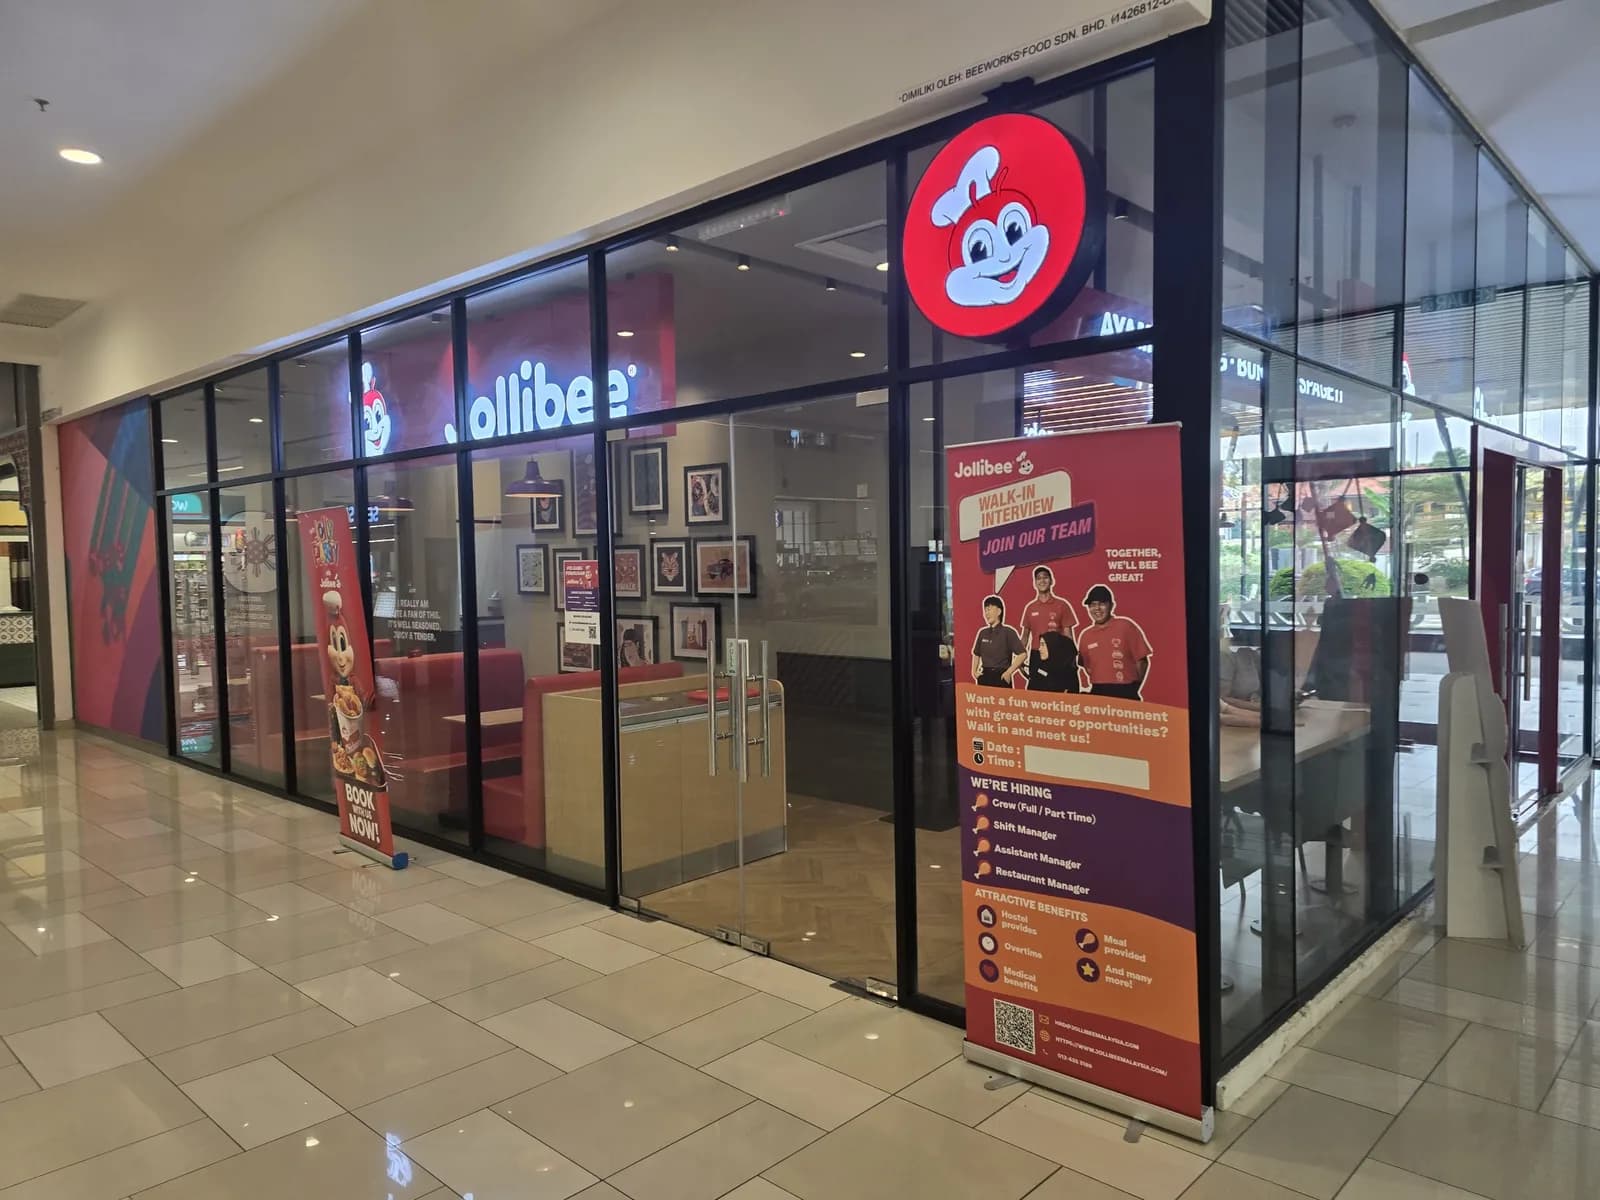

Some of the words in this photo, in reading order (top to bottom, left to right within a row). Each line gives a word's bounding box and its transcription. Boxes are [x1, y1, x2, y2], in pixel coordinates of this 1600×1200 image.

[965, 50, 1020, 78] BEEWORKS
[1110, 0, 1175, 24] (1426812-
[954, 458, 1013, 478] Jollibee
[978, 484, 1036, 511] WALK-IN
[981, 496, 1054, 527] INTERVIEW
[982, 536, 1014, 556] JOIN
[1018, 528, 1046, 547] OUR
[1050, 517, 1092, 541] TEAM
[1106, 548, 1162, 558] TOGETHER,
[1139, 560, 1158, 570] BEE
[1108, 573, 1144, 582] GREAT!
[966, 692, 996, 706] Want
[998, 698, 1006, 706] a
[1008, 696, 1028, 708] fun
[1031, 700, 1081, 714] working
[1084, 706, 1168, 722] environment
[966, 707, 990, 718] with
[993, 710, 1025, 722] great
[1028, 716, 1066, 726] career
[1068, 719, 1168, 738] opportunities?
[967, 720, 994, 732] Walk
[997, 724, 1008, 734] in
[1011, 726, 1032, 738] and
[1036, 730, 1066, 741] meet
[1070, 734, 1090, 744] us!
[987, 741, 1014, 754] Date
[987, 755, 1015, 768] Time
[345, 783, 375, 811] BOOK
[970, 776, 1008, 792] WE'RE
[1011, 784, 1052, 800] HIRING
[992, 799, 1016, 810] Crew
[1018, 802, 1037, 814] (Full
[1039, 806, 1043, 815] /
[1044, 808, 1066, 819] Part
[1067, 812, 1096, 824] Time)
[349, 813, 380, 844] NOW!
[994, 821, 1015, 832] Shift
[1018, 825, 1057, 840] Manager
[994, 844, 1038, 860] Assistant
[1040, 854, 1082, 870] Manager
[996, 866, 1045, 885] Restaurant
[1048, 878, 1091, 896] Manager
[975, 888, 1036, 910] ATTRACTIVE
[1038, 902, 1088, 922] BENEFITS
[1002, 910, 1028, 923] Hostel
[1002, 921, 1038, 935] provides
[1004, 942, 1043, 959] Overtime
[1104, 935, 1127, 947] Meal
[1104, 947, 1146, 963] provided
[1004, 966, 1036, 982] Medical
[1106, 965, 1125, 976] And
[1127, 971, 1152, 984] many
[1106, 976, 1132, 989] more!
[1004, 978, 1038, 992] benefits
